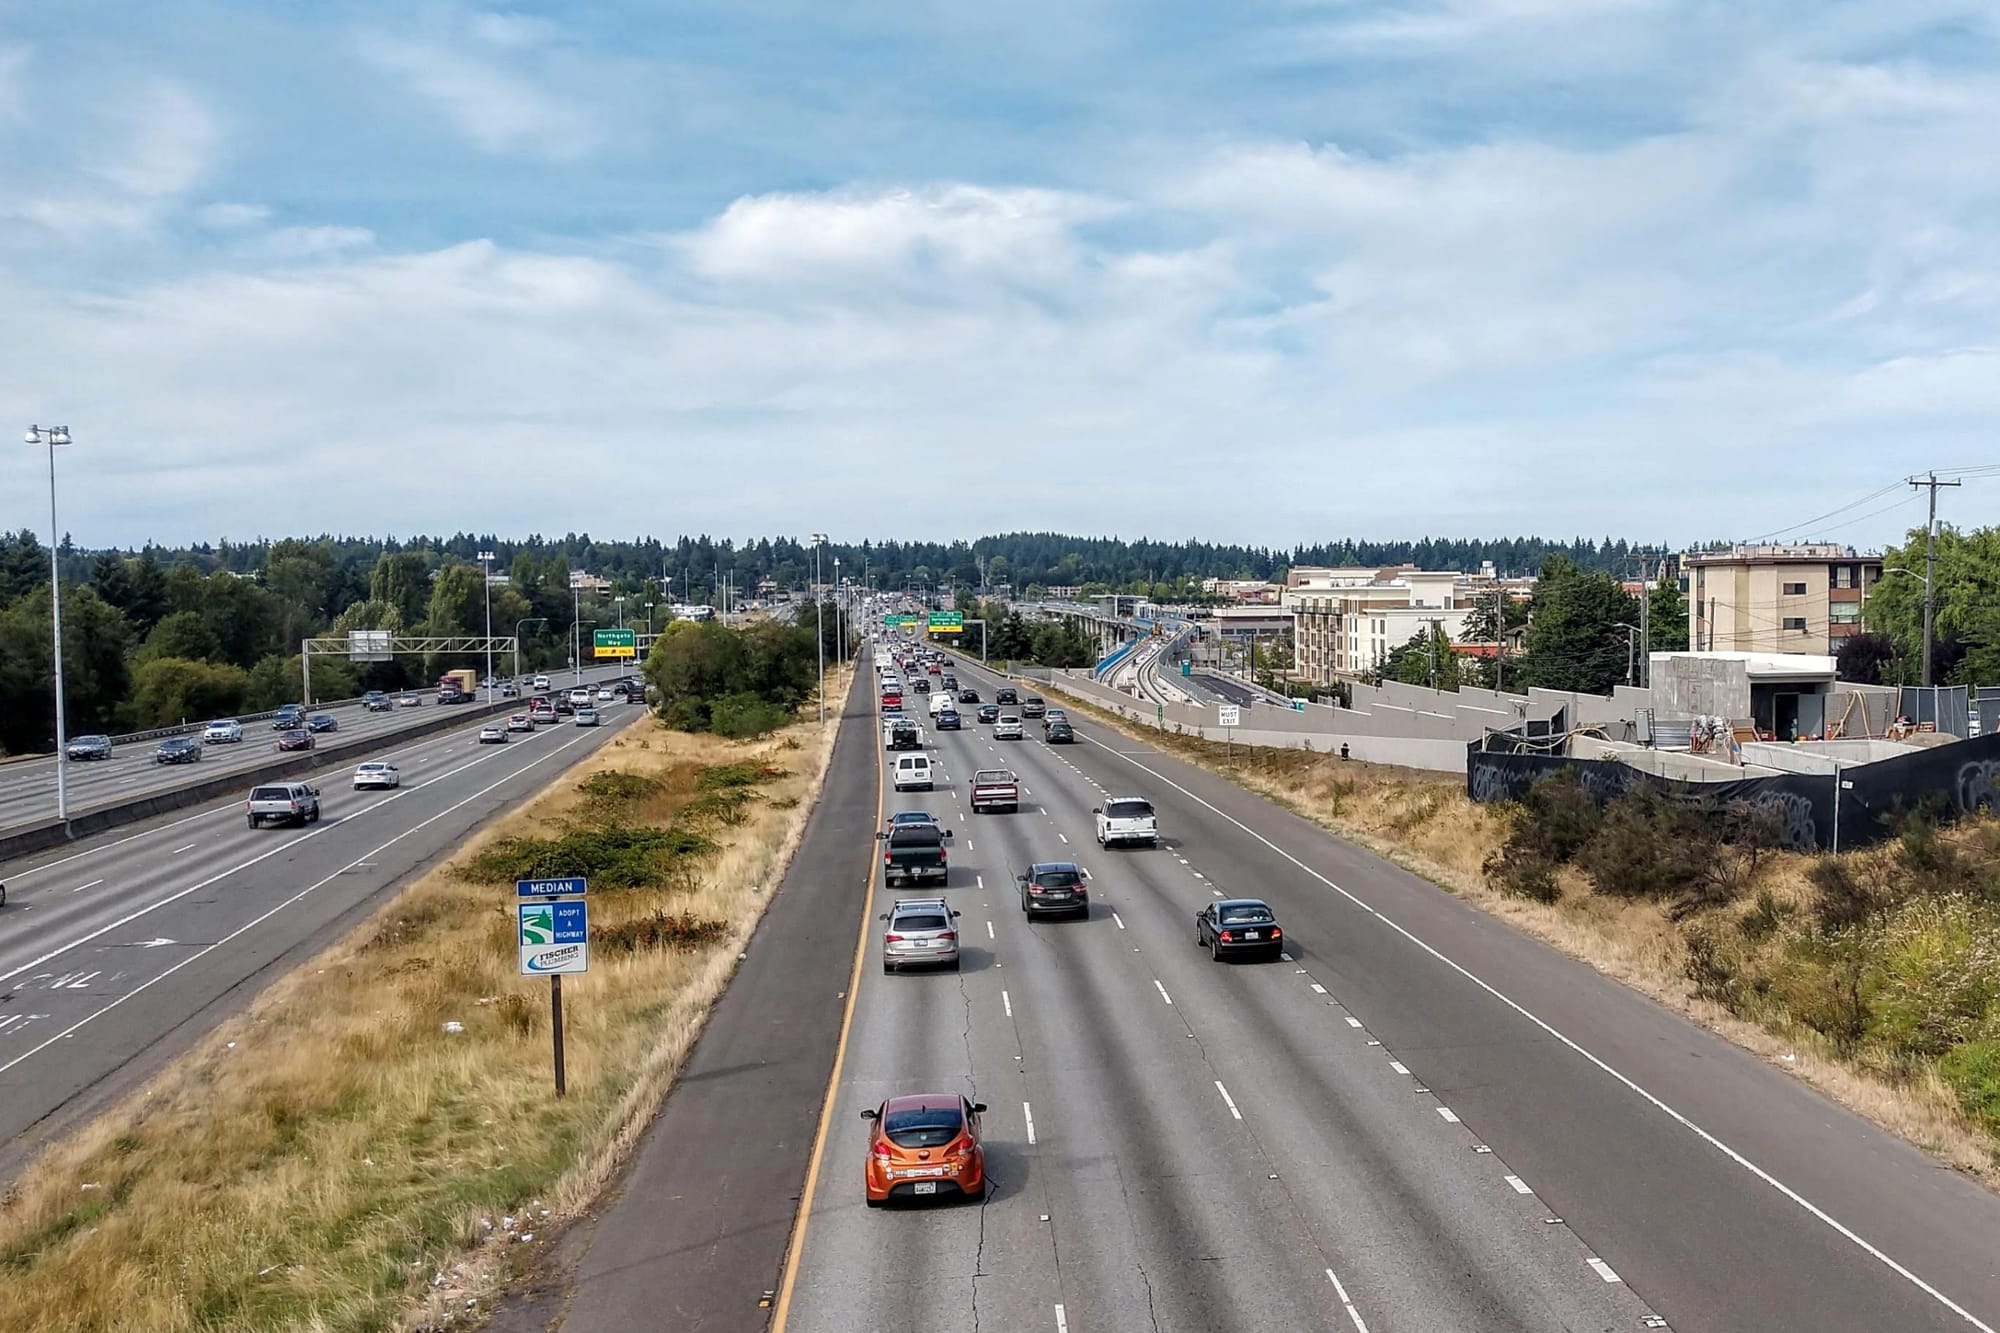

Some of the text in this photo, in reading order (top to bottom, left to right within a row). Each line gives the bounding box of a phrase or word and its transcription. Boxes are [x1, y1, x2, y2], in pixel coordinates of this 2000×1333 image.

[531, 882, 573, 894] MEDIAN
[559, 908, 580, 917] ADOPT
[555, 930, 584, 939] HIGHWAY
[539, 945, 579, 961] FISCHER
